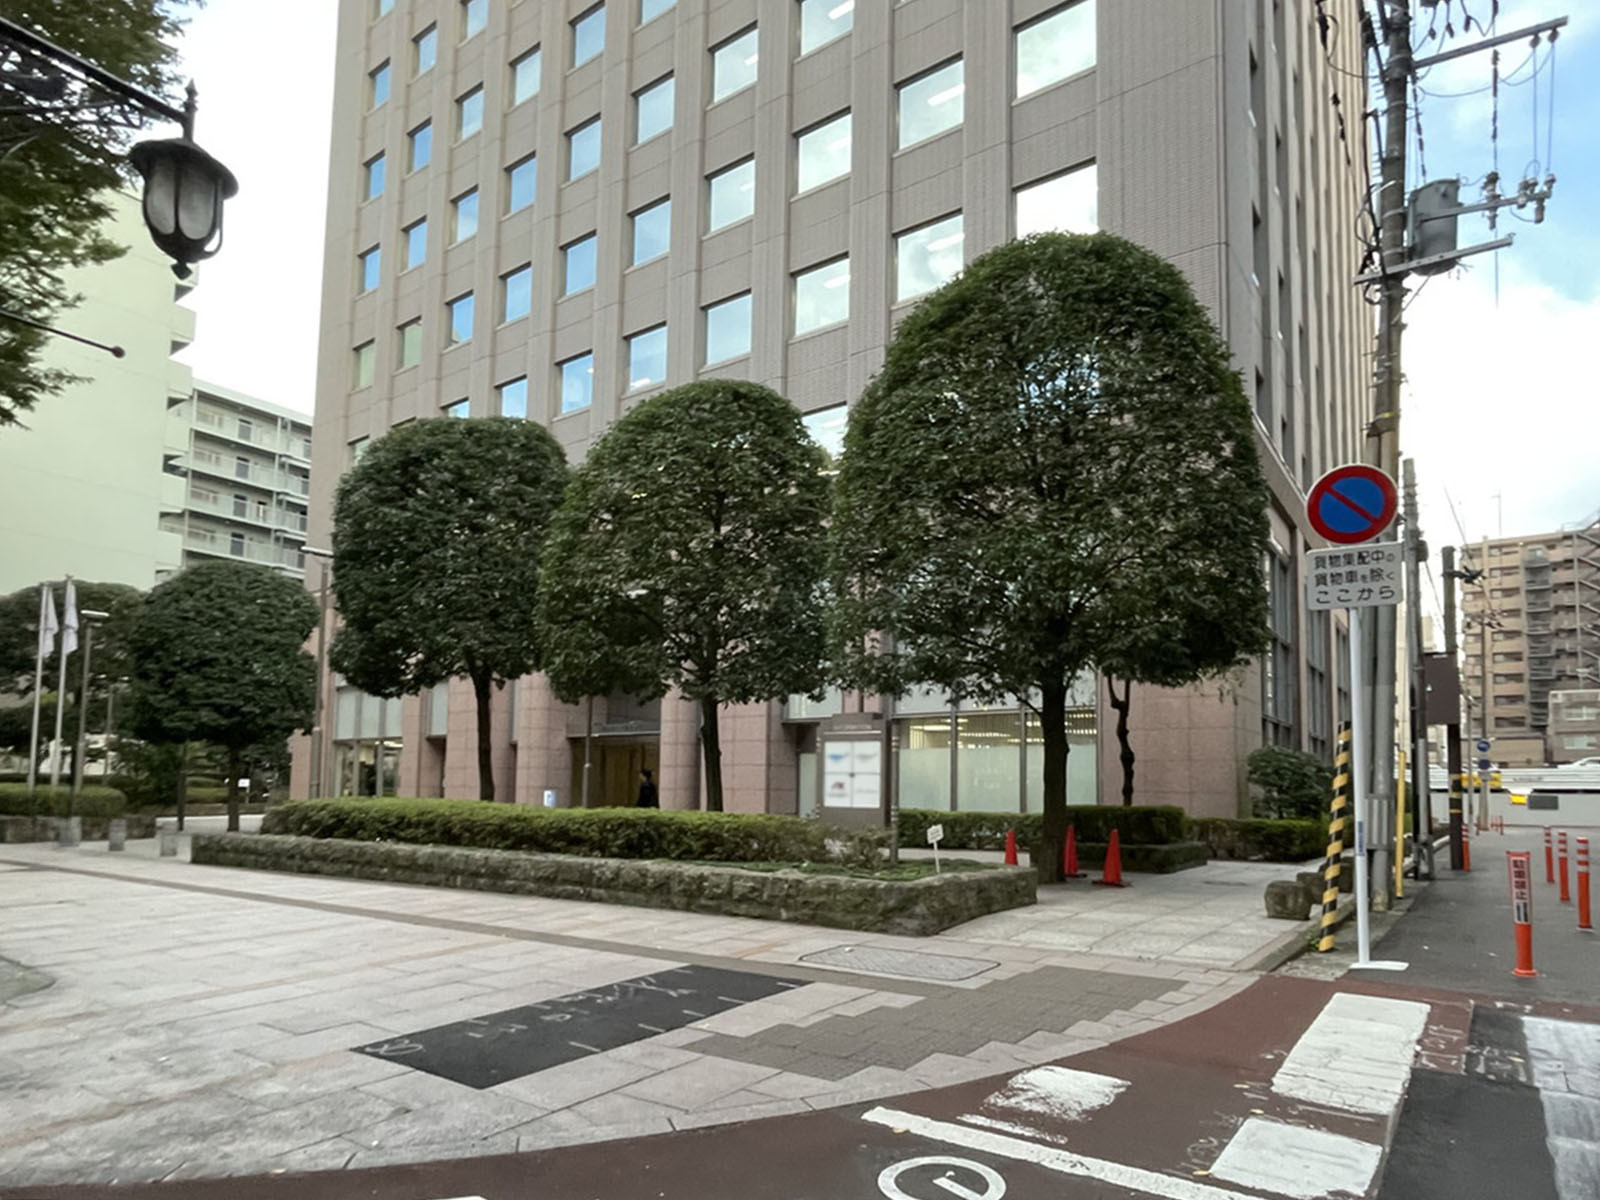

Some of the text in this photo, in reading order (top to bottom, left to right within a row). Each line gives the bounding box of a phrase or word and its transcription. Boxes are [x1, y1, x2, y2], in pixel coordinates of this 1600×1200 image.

[1314, 550, 1396, 569] 貨物集配中の
[1314, 567, 1395, 587] 貨物車を除く
[1316, 585, 1395, 604] ここから
